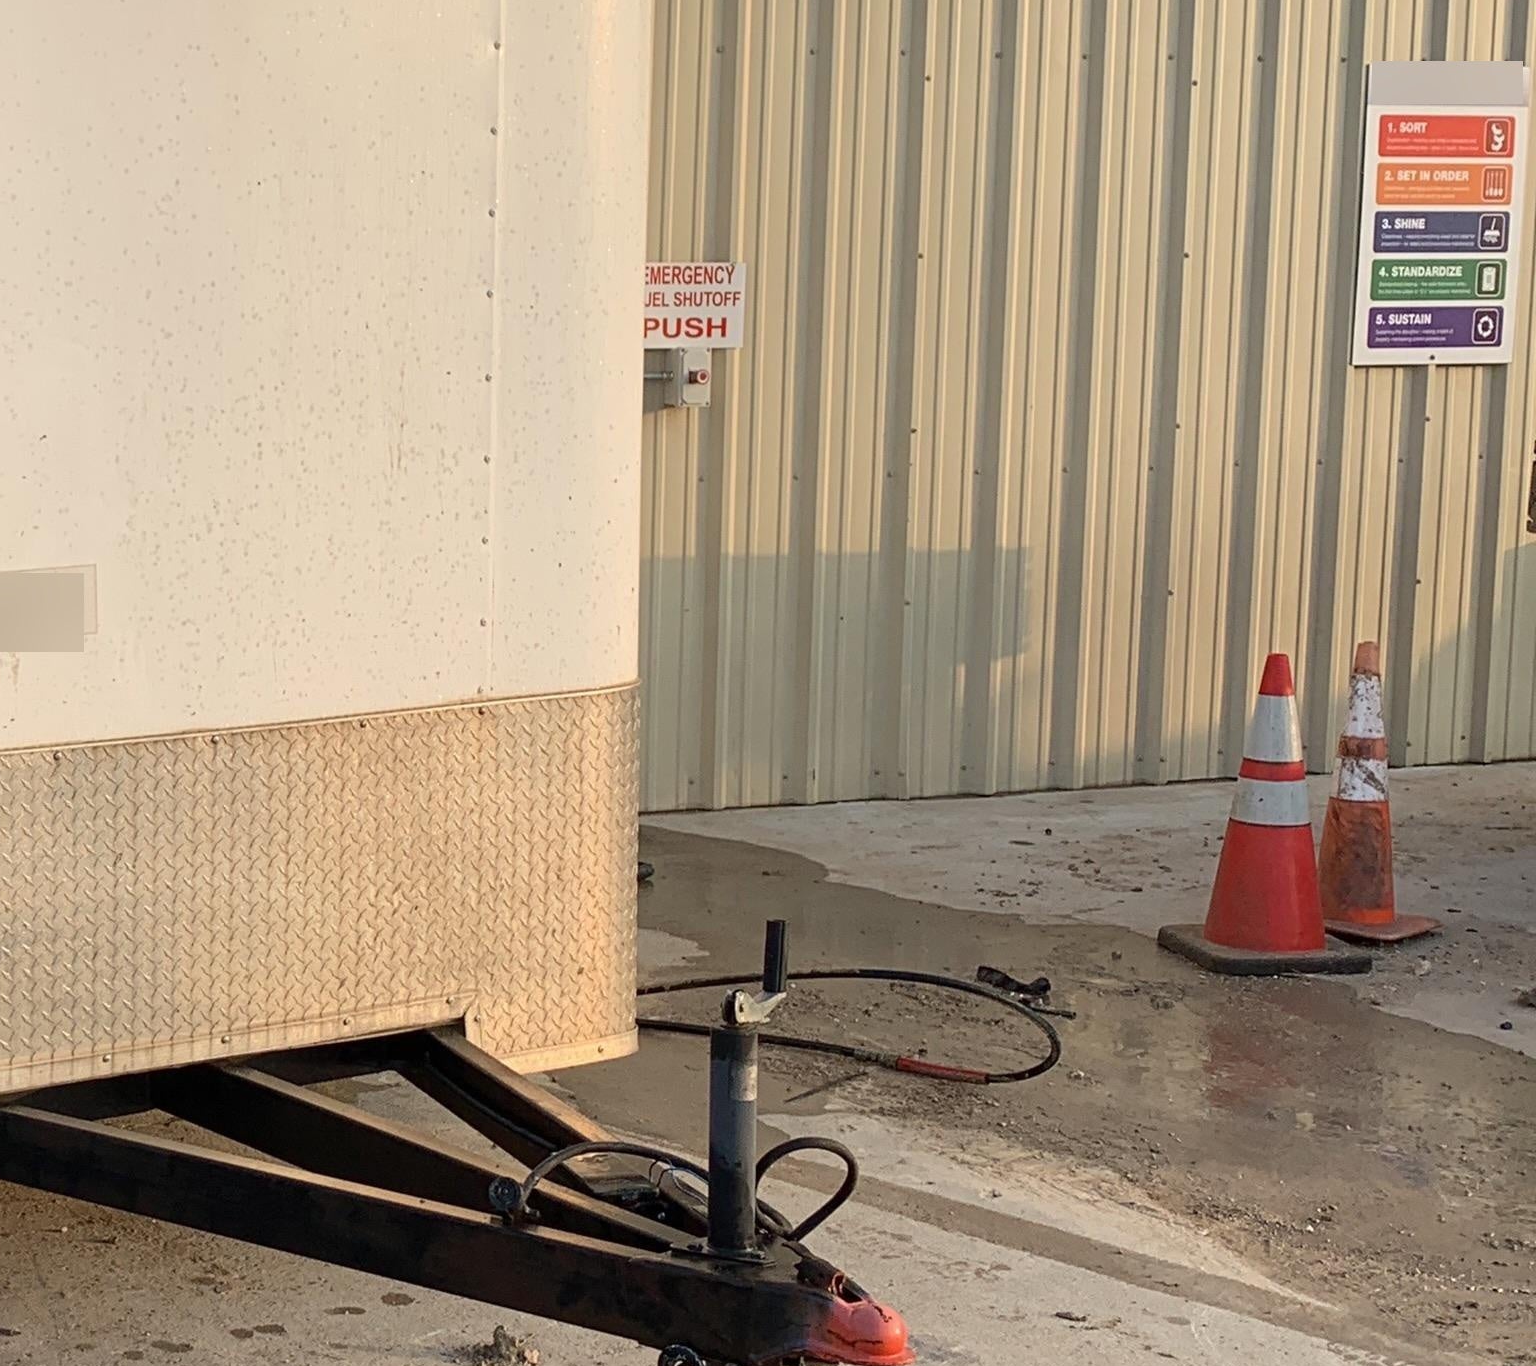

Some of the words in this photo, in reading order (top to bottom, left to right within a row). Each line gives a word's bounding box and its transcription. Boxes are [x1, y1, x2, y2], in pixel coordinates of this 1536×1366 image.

[1387, 122, 1397, 133] 1.
[1399, 122, 1428, 133] SORT
[1384, 171, 1394, 181] 2.
[1397, 170, 1417, 181] SET
[1420, 170, 1431, 181] IN
[1433, 170, 1469, 181] ORDER
[1381, 218, 1392, 229] 3.
[1394, 218, 1426, 229] SHINE
[1378, 267, 1389, 277] 4.
[1391, 266, 1463, 277] STANDARDIZE
[673, 291, 742, 307] SHUTOFF
[1375, 314, 1386, 325] 5.
[1388, 313, 1432, 325] SUSTAIN
[643, 317, 727, 339] PUSH
